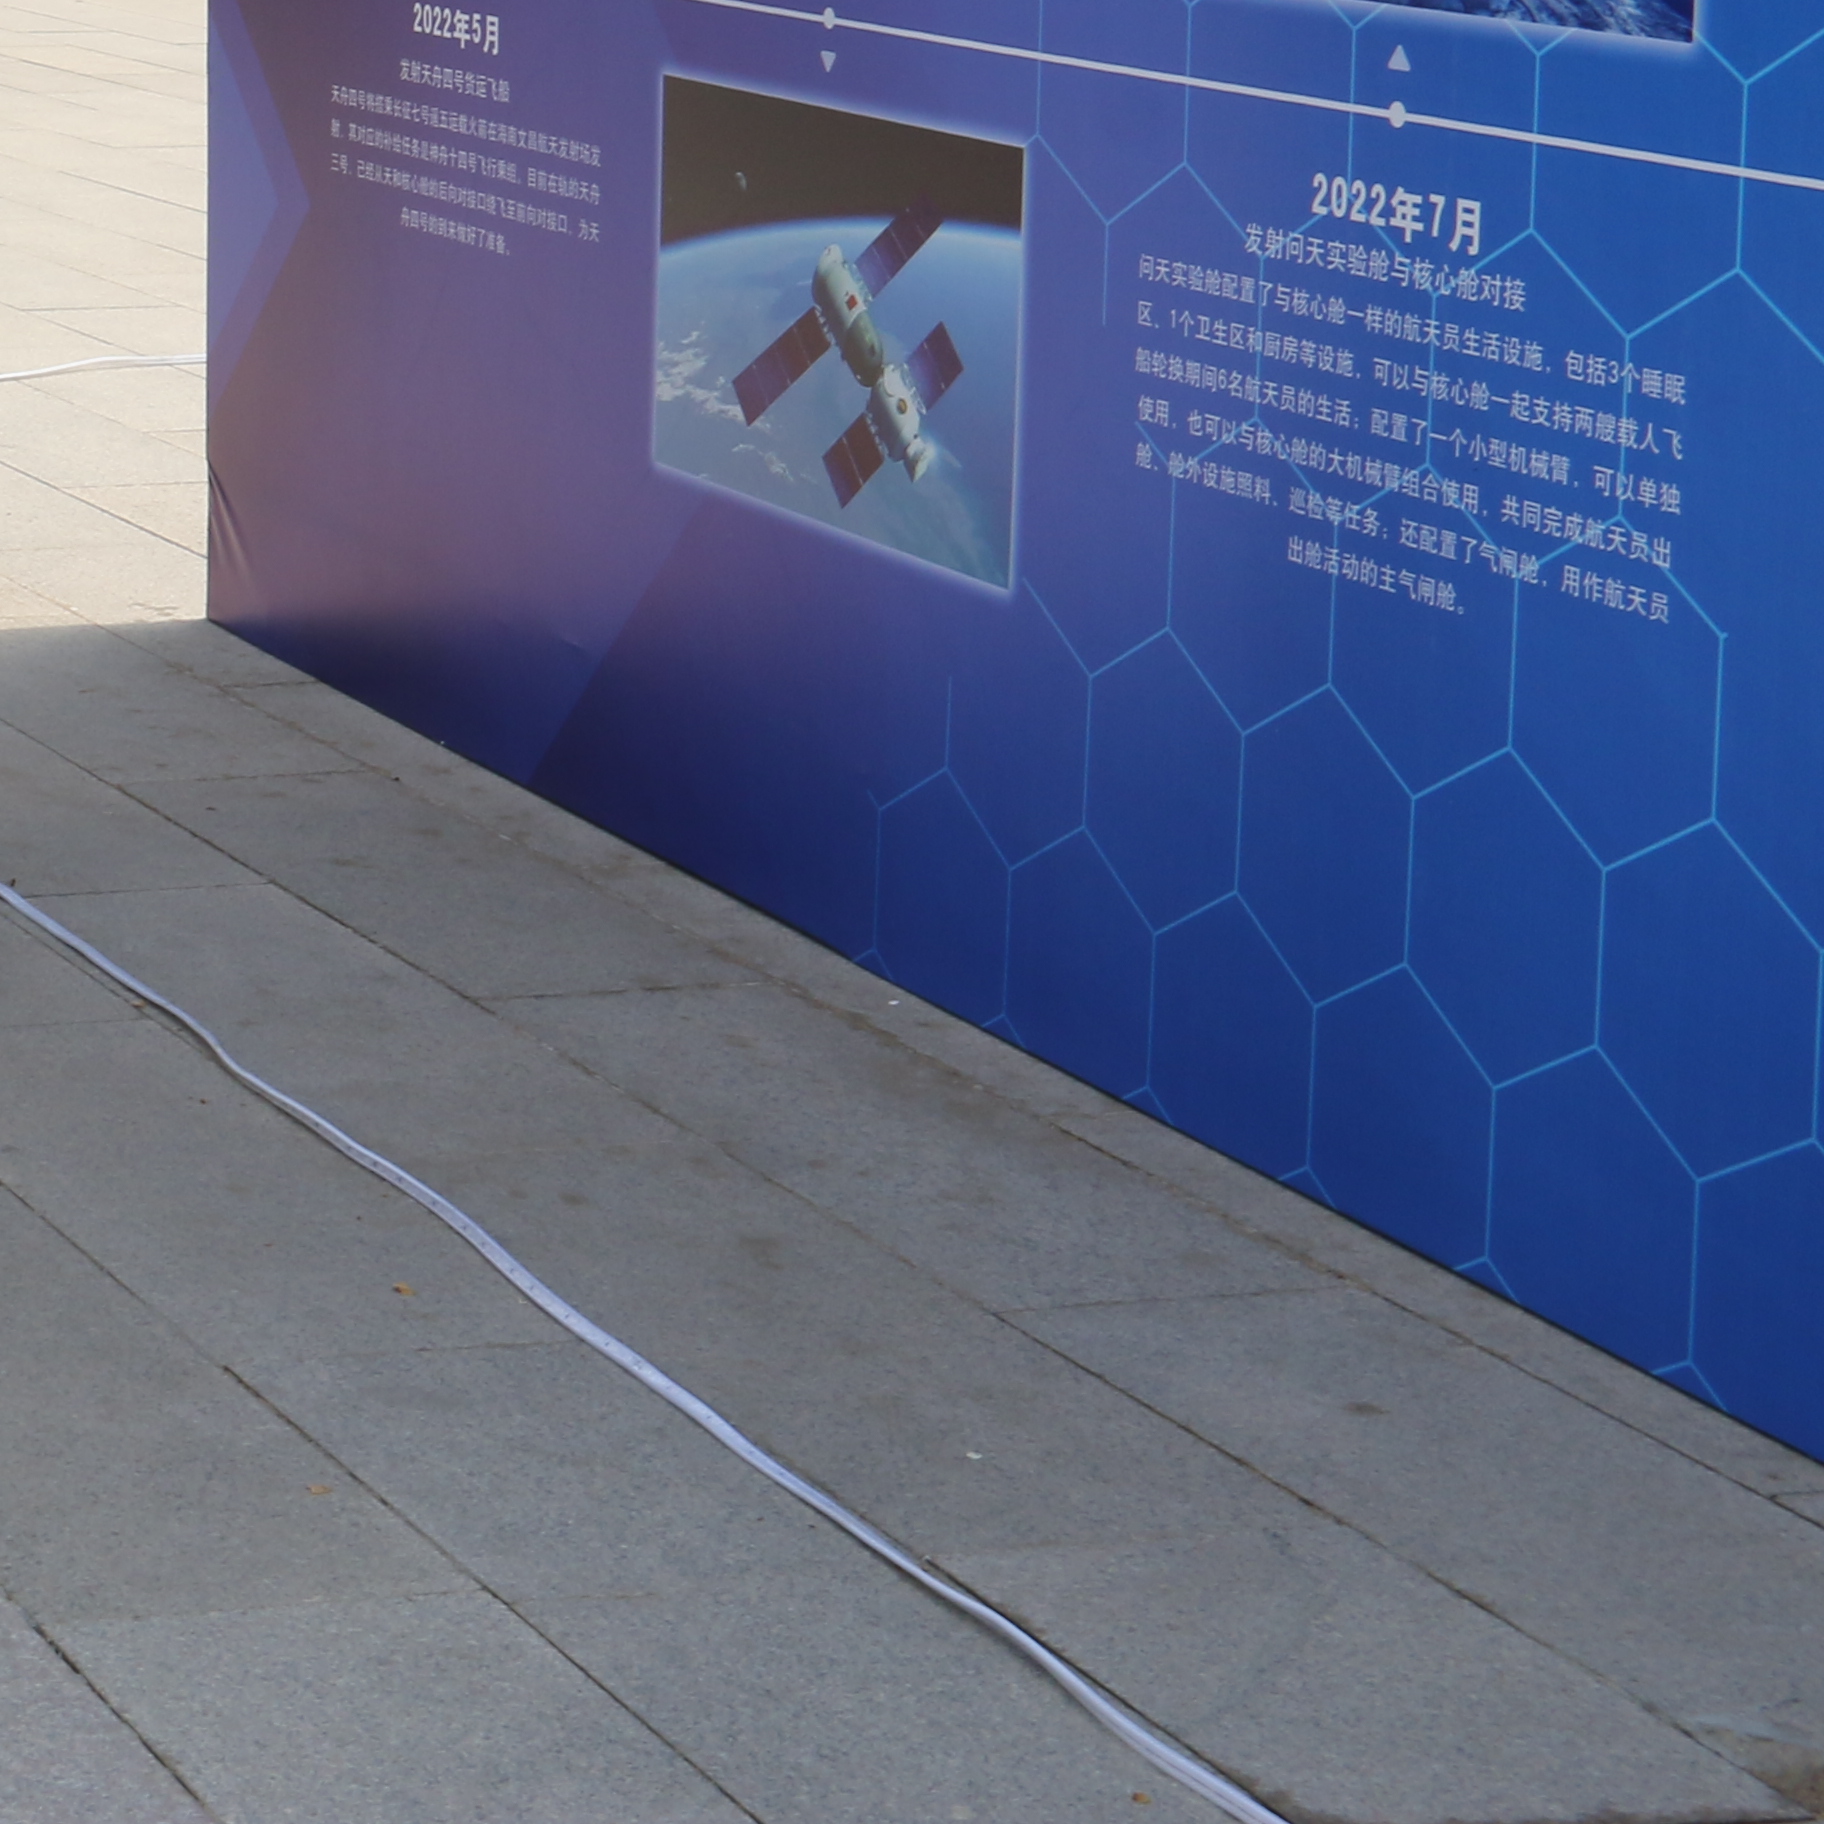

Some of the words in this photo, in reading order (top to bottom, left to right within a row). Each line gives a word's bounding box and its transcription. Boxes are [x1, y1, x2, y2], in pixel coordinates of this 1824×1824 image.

[413, 2, 501, 56] 2022年5月
[399, 58, 511, 104] 发射天舟四号货运飞船
[1311, 172, 1483, 256] 2022年7月
[1245, 222, 1527, 314] 发射问天实验舱与核心舱对接
[1138, 253, 1686, 406] 问天实验舱配置了与核心舱一样的航天员生活设施，包括3个睡眠
[1287, 536, 1468, 616] 出舱活动的主气闸舱。
